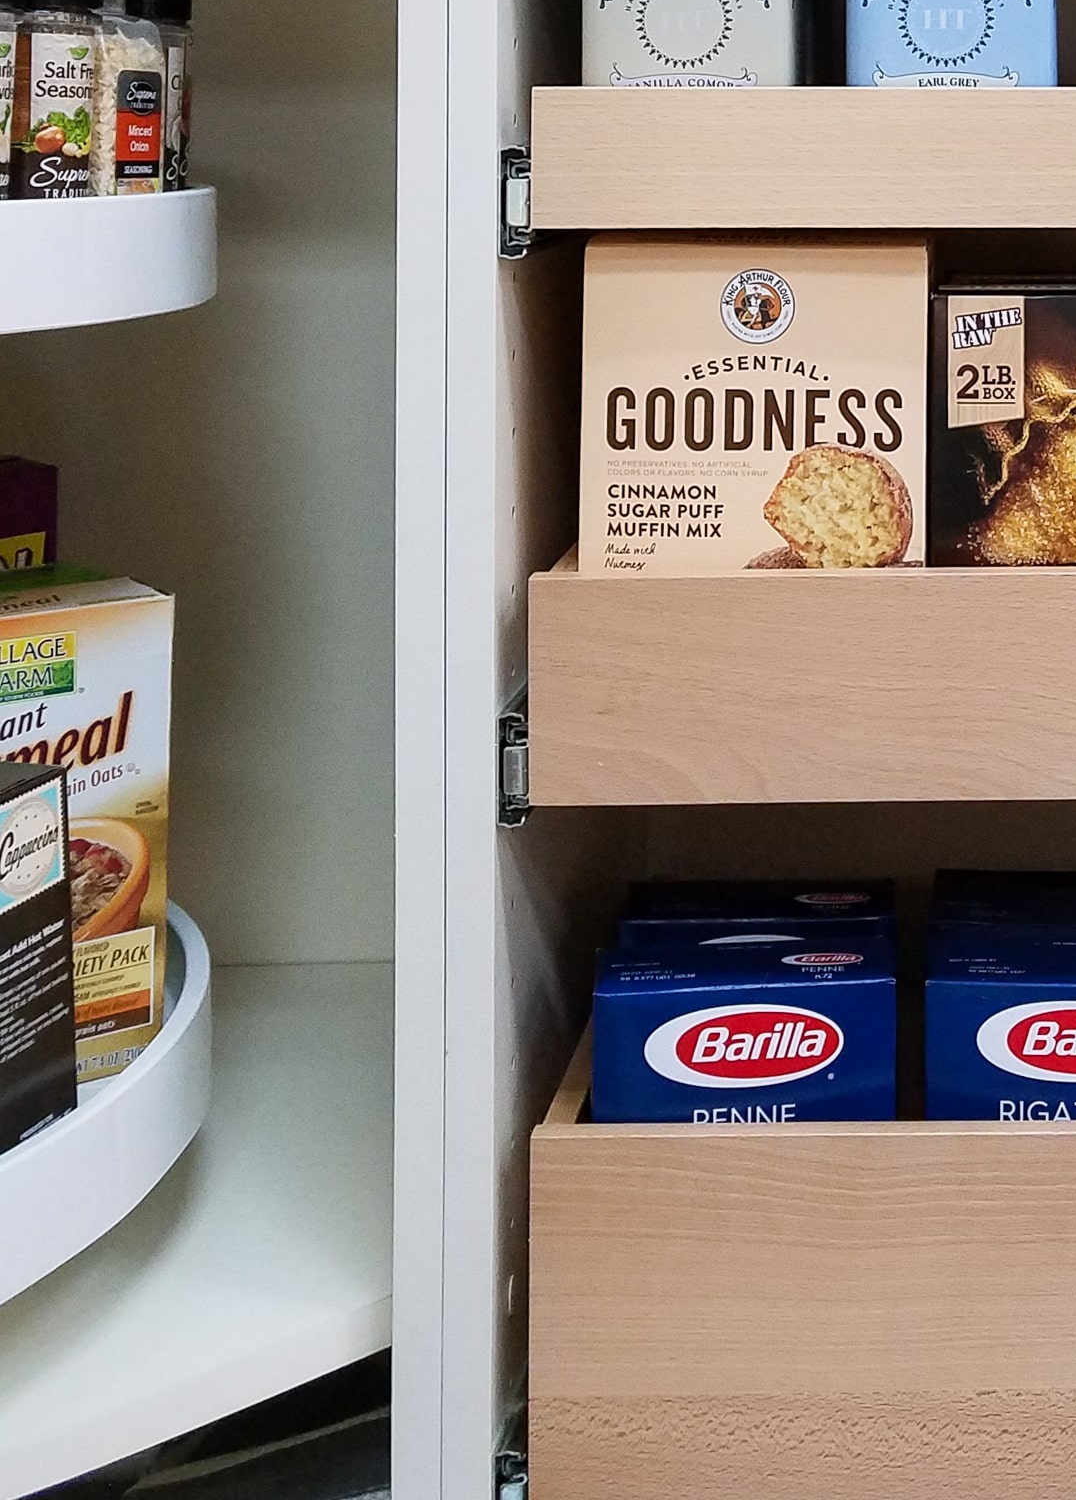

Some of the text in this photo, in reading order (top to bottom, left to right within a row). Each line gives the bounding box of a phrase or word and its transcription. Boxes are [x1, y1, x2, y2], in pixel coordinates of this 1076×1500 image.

[44, 61, 76, 79] Salt
[623, 78, 743, 87] NILLA COMOR
[918, 77, 980, 87] EARL GREY
[128, 125, 153, 136] Minced
[130, 141, 149, 152] Onion
[722, 272, 790, 307] KING ARTHUR FLOUR
[957, 308, 1021, 332] IN THE
[953, 330, 994, 348] RAW
[692, 356, 819, 381] ESSENTIAL
[957, 365, 1016, 400] 2 LB.
[983, 388, 1015, 399] BOX
[606, 387, 903, 452] GOODNESS
[608, 484, 716, 499] CINNAMON
[607, 503, 724, 518] SUGAR PUFF
[607, 522, 722, 537] MUFFIN MIX
[605, 543, 631, 555] Made
[0, 638, 66, 664] LLAGE
[0, 666, 52, 690] ARM
[0, 702, 48, 741] ant
[6, 690, 134, 771] meal
[66, 763, 123, 797] ain Oats
[0, 825, 58, 880] Cappuccino
[75, 955, 107, 976] IETY
[110, 944, 149, 968] PACK
[801, 954, 857, 964] Barilla
[691, 1021, 828, 1063] Barilla
[693, 1104, 796, 1124] PENNE
